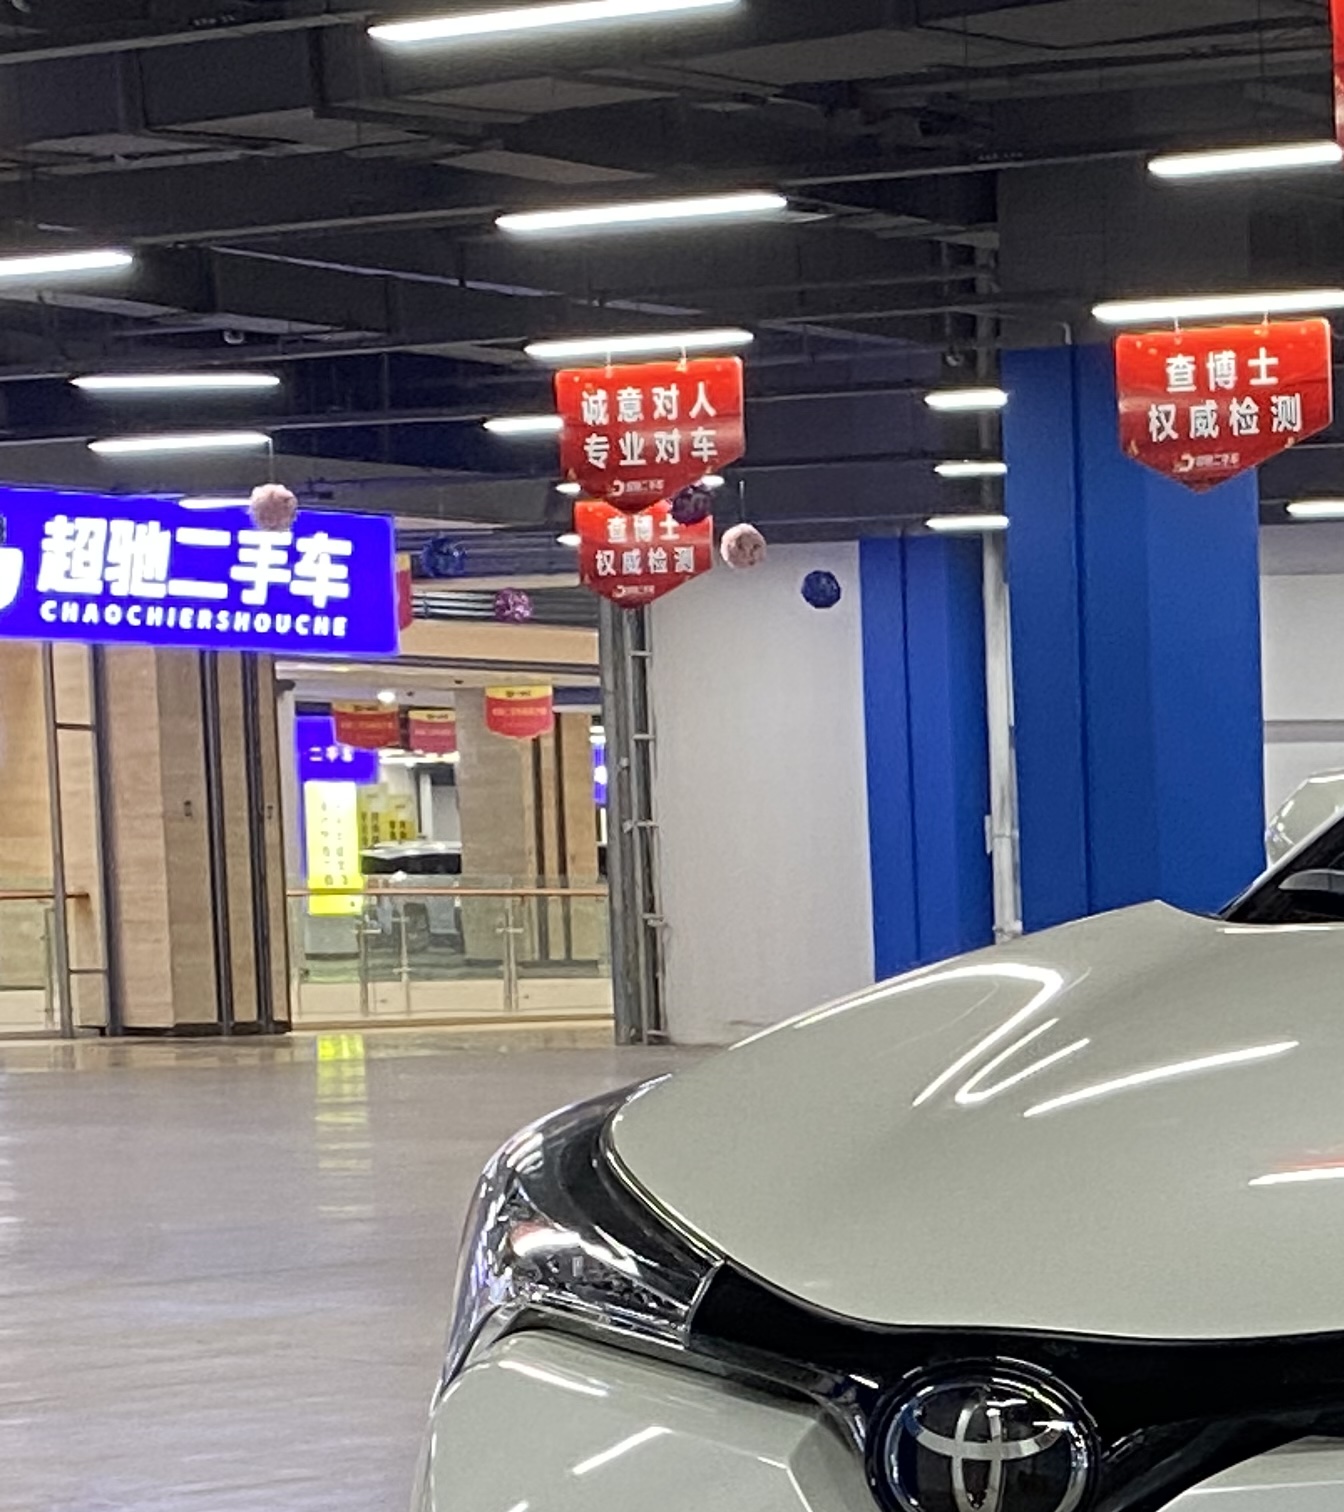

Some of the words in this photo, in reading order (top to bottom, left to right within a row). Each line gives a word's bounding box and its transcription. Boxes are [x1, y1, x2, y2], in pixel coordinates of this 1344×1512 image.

[1166, 347, 1279, 393] 查博士
[581, 381, 717, 426] 诚意对人
[1148, 393, 1303, 443] 权威检测
[583, 426, 718, 469] 专业对车
[606, 514, 680, 543] 查博士
[37, 514, 354, 609] 超驰二手车
[595, 547, 696, 576] 权威检测
[39, 600, 349, 637] CHAOCHIERSHOUCHE
